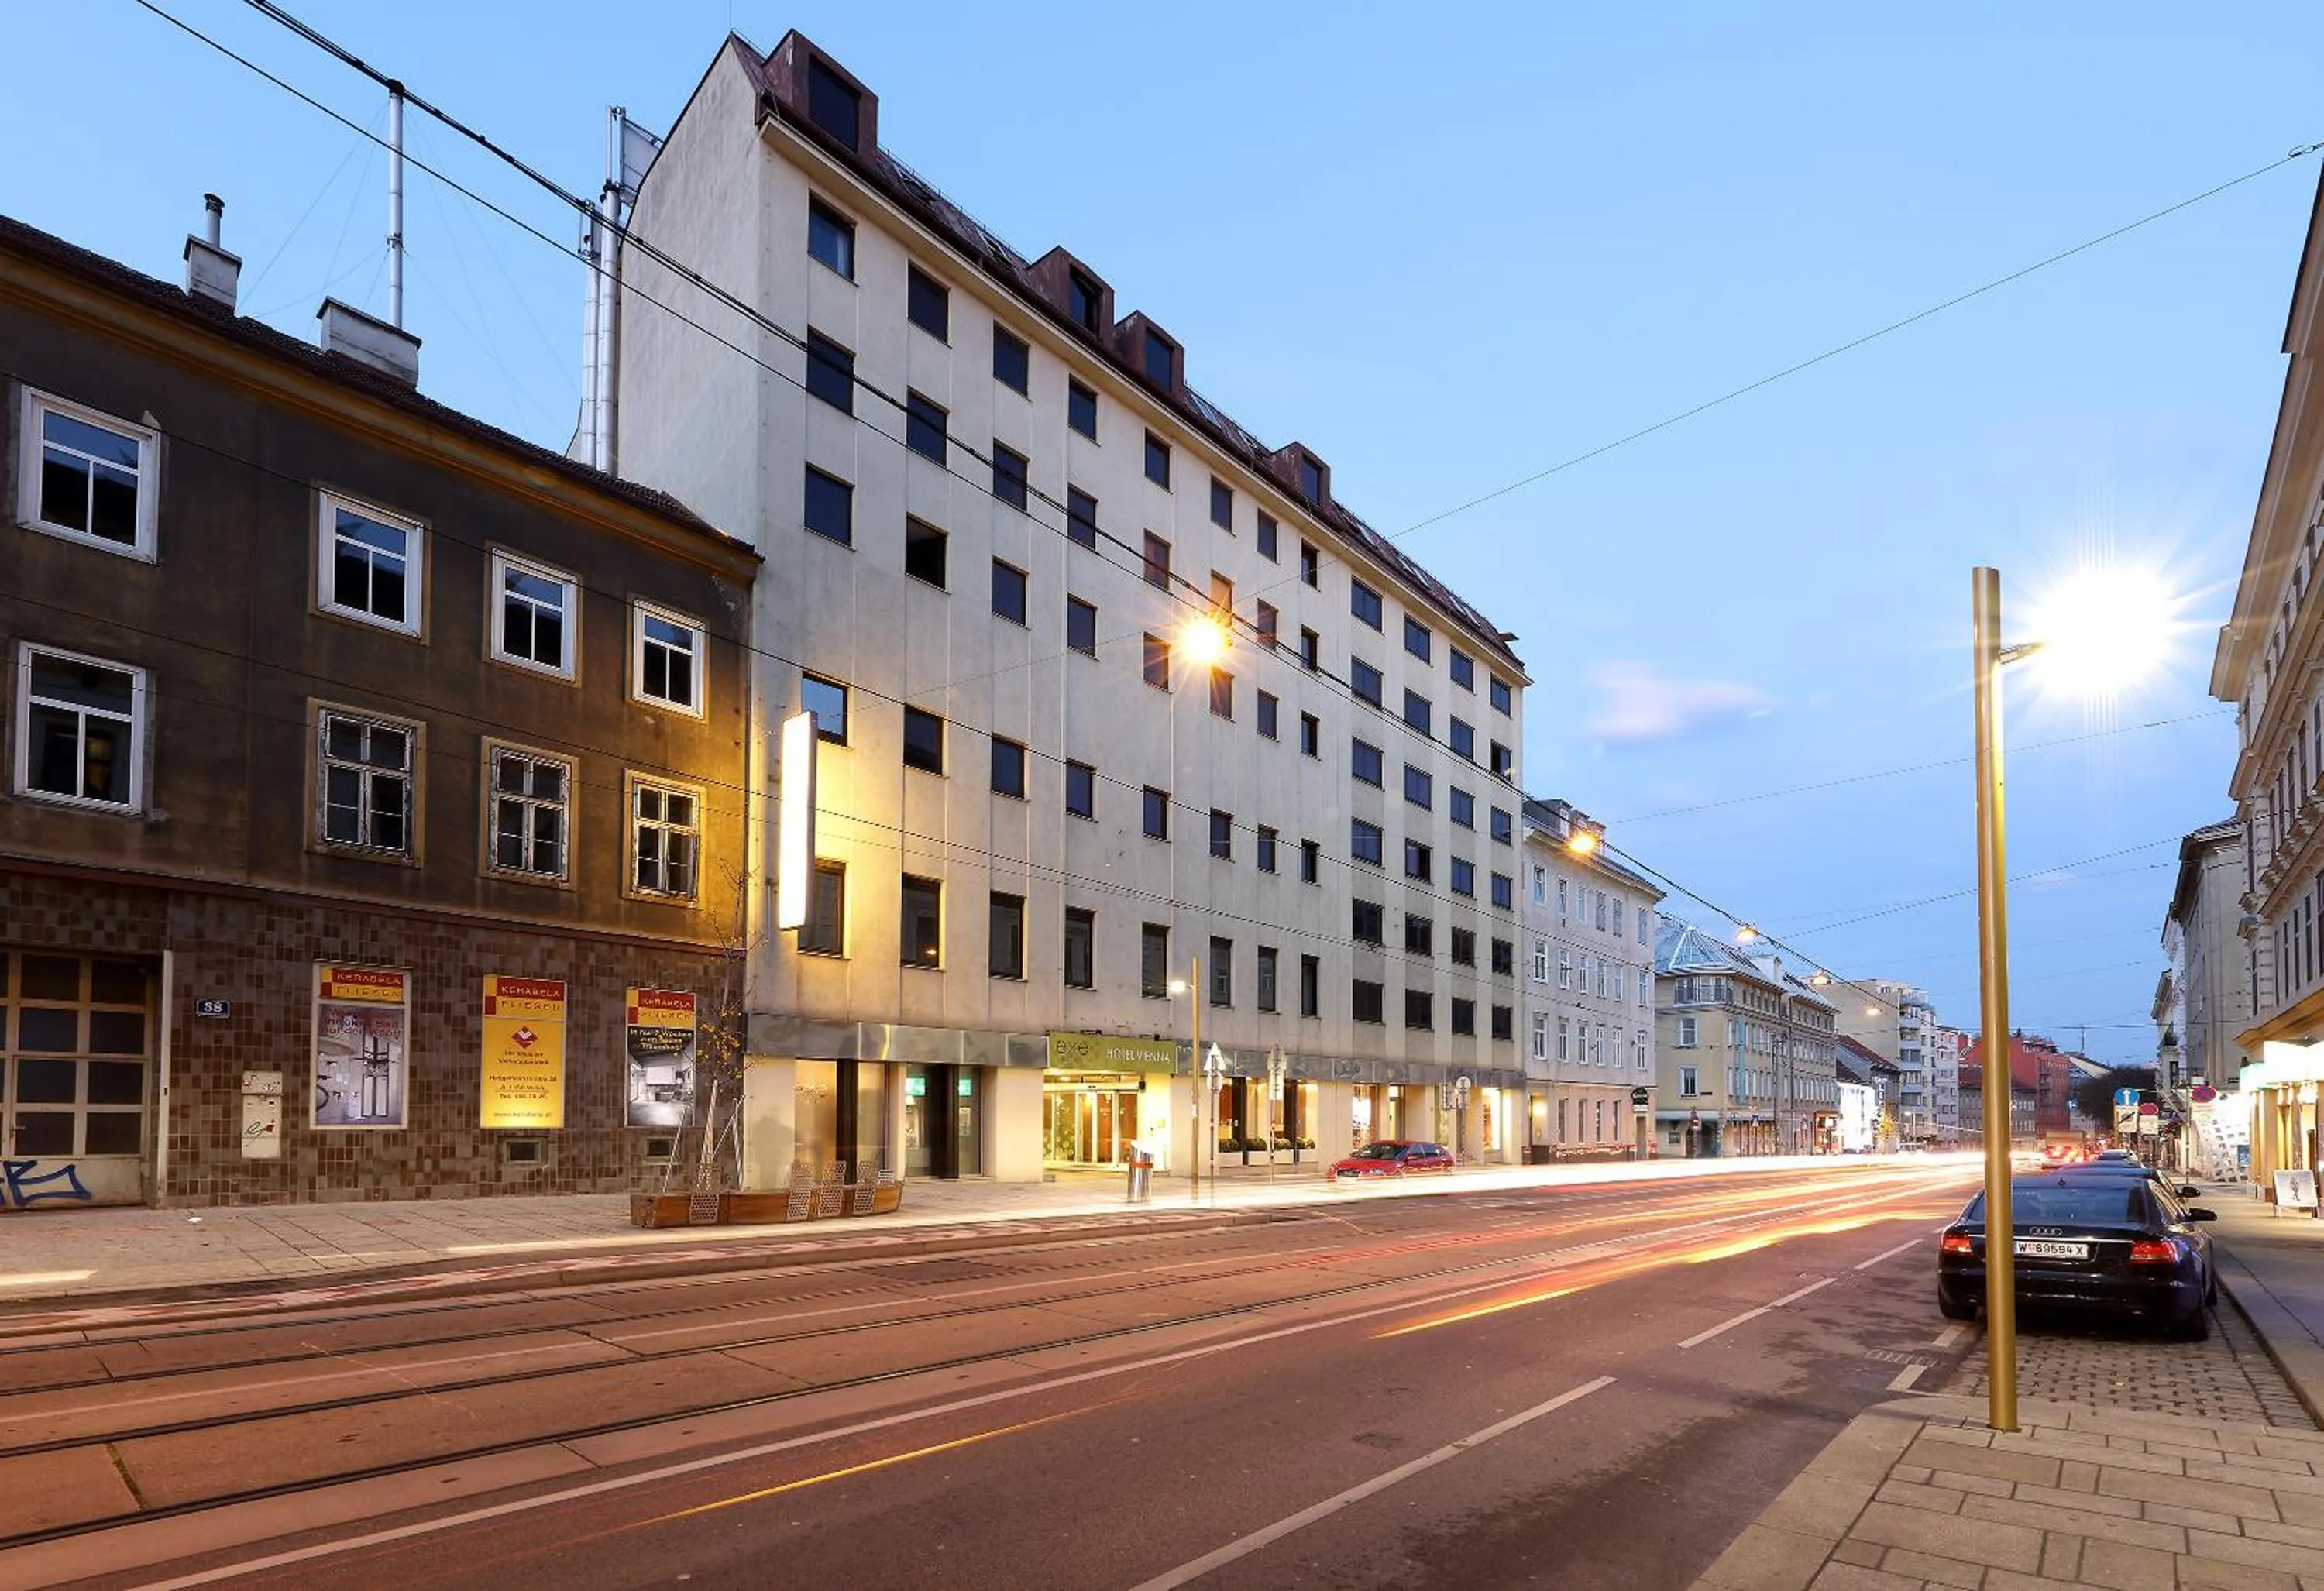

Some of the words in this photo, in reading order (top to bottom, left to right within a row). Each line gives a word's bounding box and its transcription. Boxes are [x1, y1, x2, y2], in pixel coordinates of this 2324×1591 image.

[501, 986, 560, 997] KERABELA
[1056, 1040, 1089, 1056] exe
[1107, 1048, 1134, 1060] HOTEL
[1136, 1052, 1171, 1064] VIENNA
